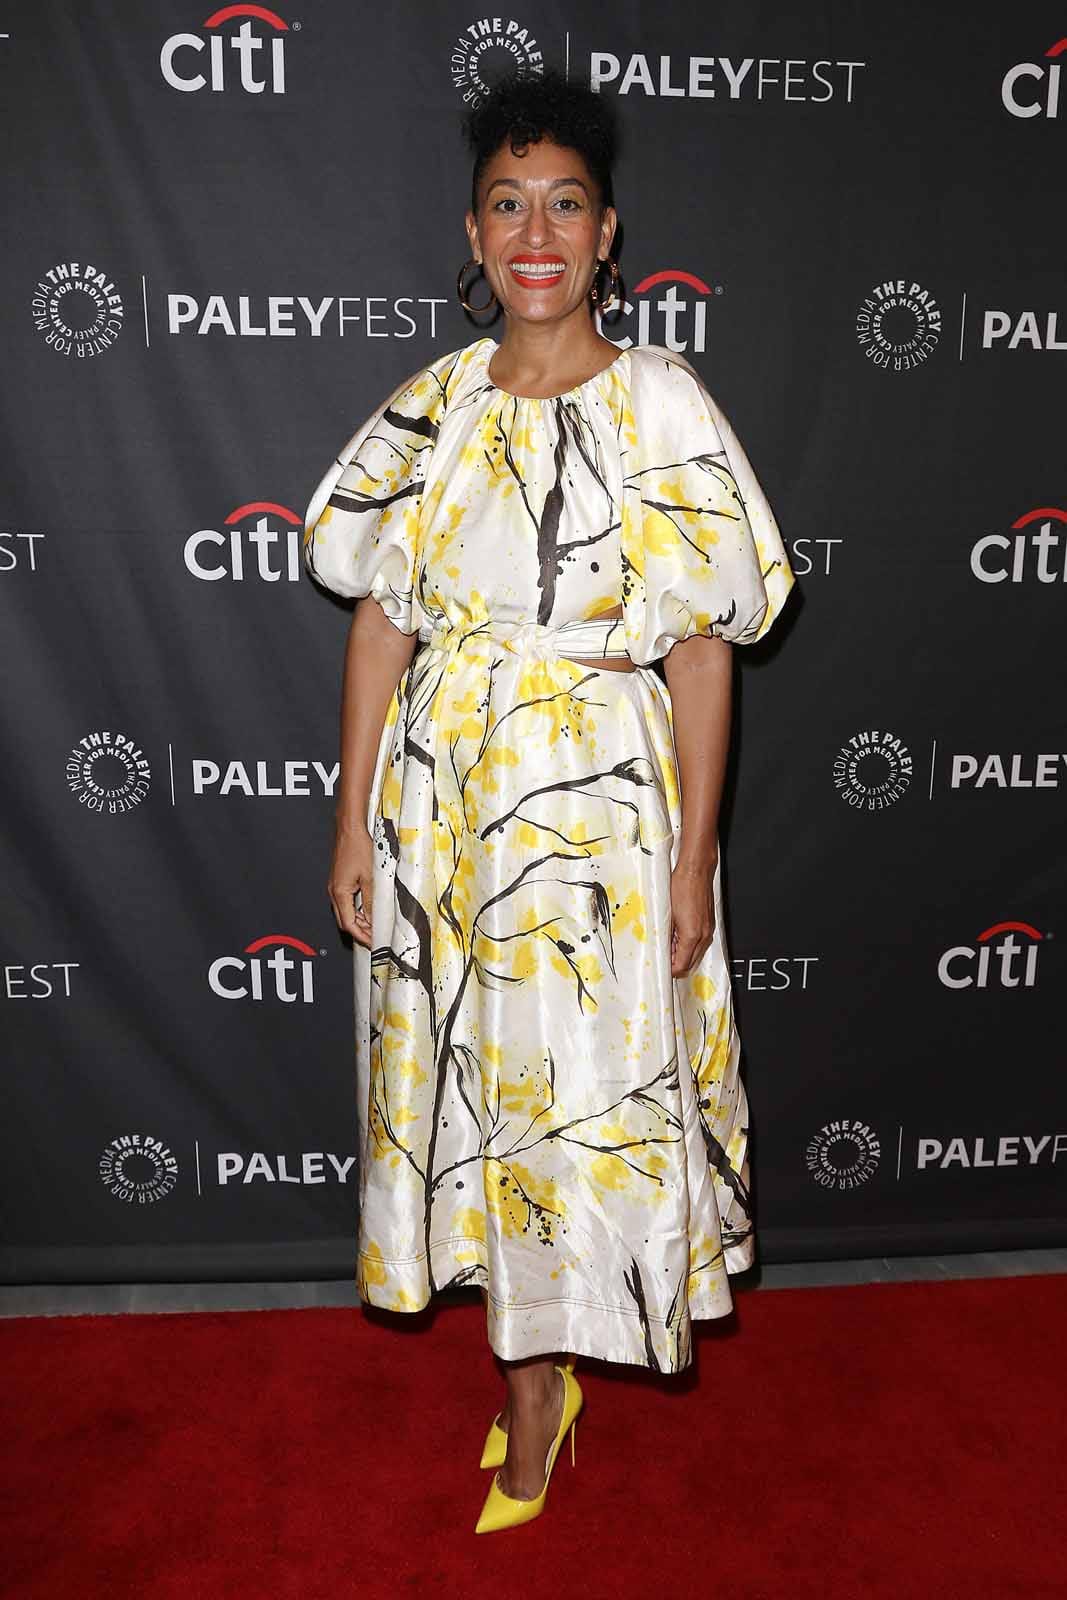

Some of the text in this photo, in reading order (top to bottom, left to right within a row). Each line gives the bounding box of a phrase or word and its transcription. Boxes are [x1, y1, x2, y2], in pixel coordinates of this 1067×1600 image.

[467, 18, 502, 39] THE
[451, 38, 473, 87] MEDIA
[474, 38, 494, 55] FOR
[496, 37, 525, 65] MEDIA
[506, 20, 544, 75] PALEY
[590, 51, 865, 103] PALEYFEST
[54, 282, 72, 298] FOR
[75, 281, 104, 307] MEDIA
[879, 298, 897, 314] FOR
[32, 263, 123, 357] THE PALEY CENTER FOR MEDIA
[50, 299, 72, 337] CENTER
[168, 293, 448, 339] PALEYFEST
[856, 280, 942, 371] THE PALEY CENTER FOR MEDIA
[899, 298, 925, 322] MEDIA
[873, 314, 892, 351] CENTER
[971, 522, 1067, 584] cit
[87, 748, 105, 762] FOR
[106, 747, 133, 770] MEDIA
[854, 747, 871, 761] FOR
[873, 746, 897, 768] MEDIA
[66, 731, 151, 814] THE PALEY CENTER FOR MEDIA
[83, 763, 105, 796] CENTER
[193, 758, 339, 797] PALEY
[833, 731, 913, 810] THE PALEY CENTER FOR MEDIA
[848, 761, 866, 793] CENTER
[111, 1135, 141, 1151] THE
[821, 1120, 850, 1136] THE
[852, 1121, 881, 1158] PALEY
[99, 1148, 117, 1185] MEDIA
[143, 1136, 179, 1174] PALEY
[217, 1153, 355, 1185] PALEY
[111, 1183, 134, 1202] FOR
[814, 1170, 836, 1188] FOR
